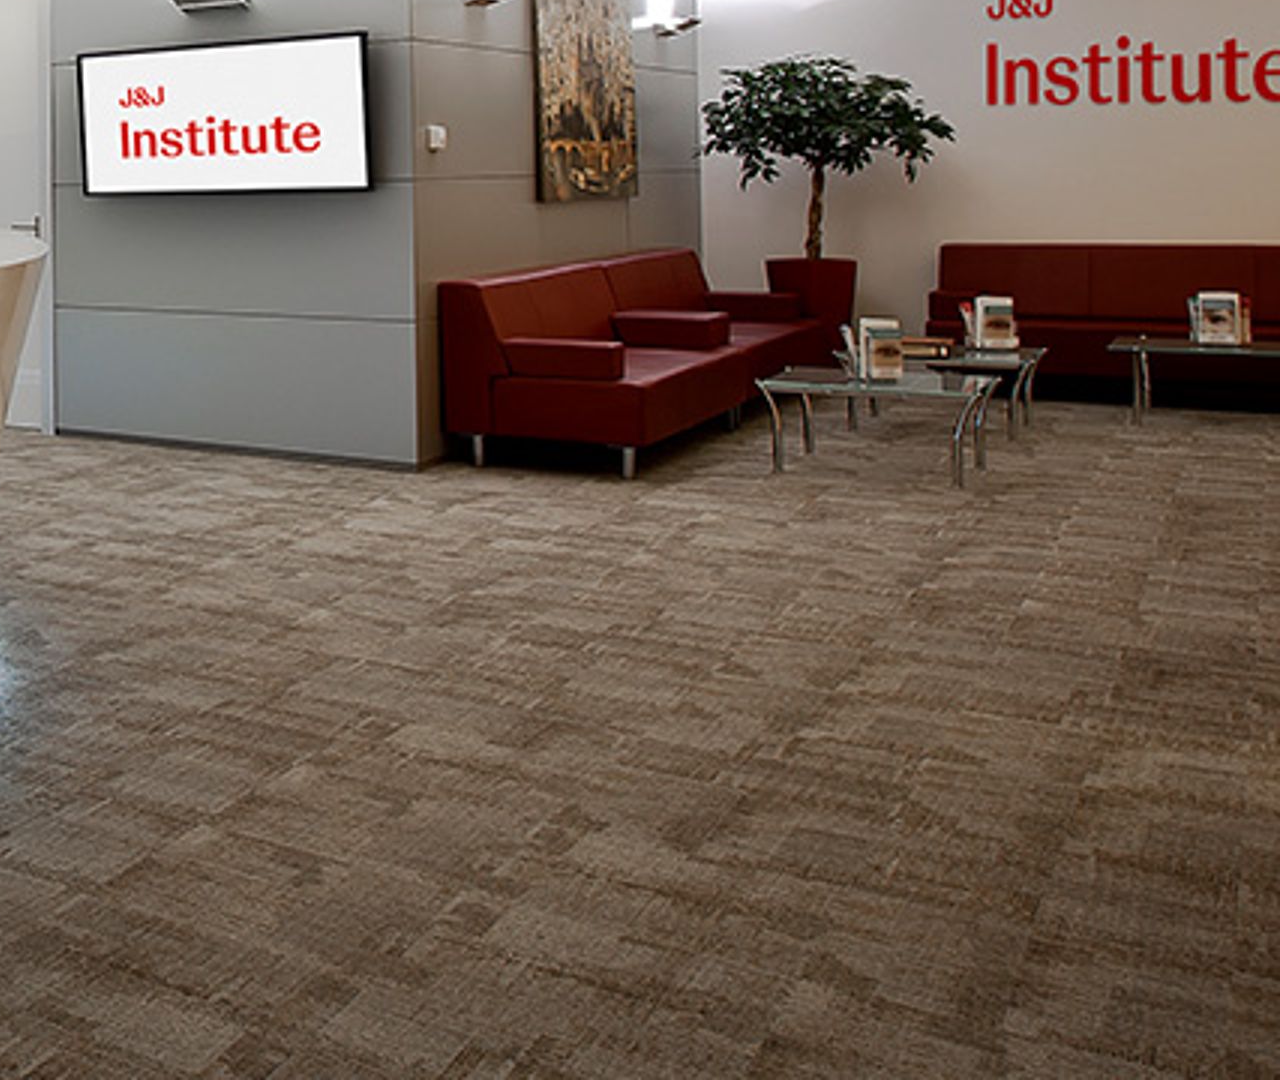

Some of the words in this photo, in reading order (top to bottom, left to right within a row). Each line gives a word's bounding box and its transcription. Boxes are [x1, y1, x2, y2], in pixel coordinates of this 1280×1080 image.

[986, 35, 1280, 106] Institute
[118, 86, 166, 108] J&J
[119, 115, 322, 160] Institute
